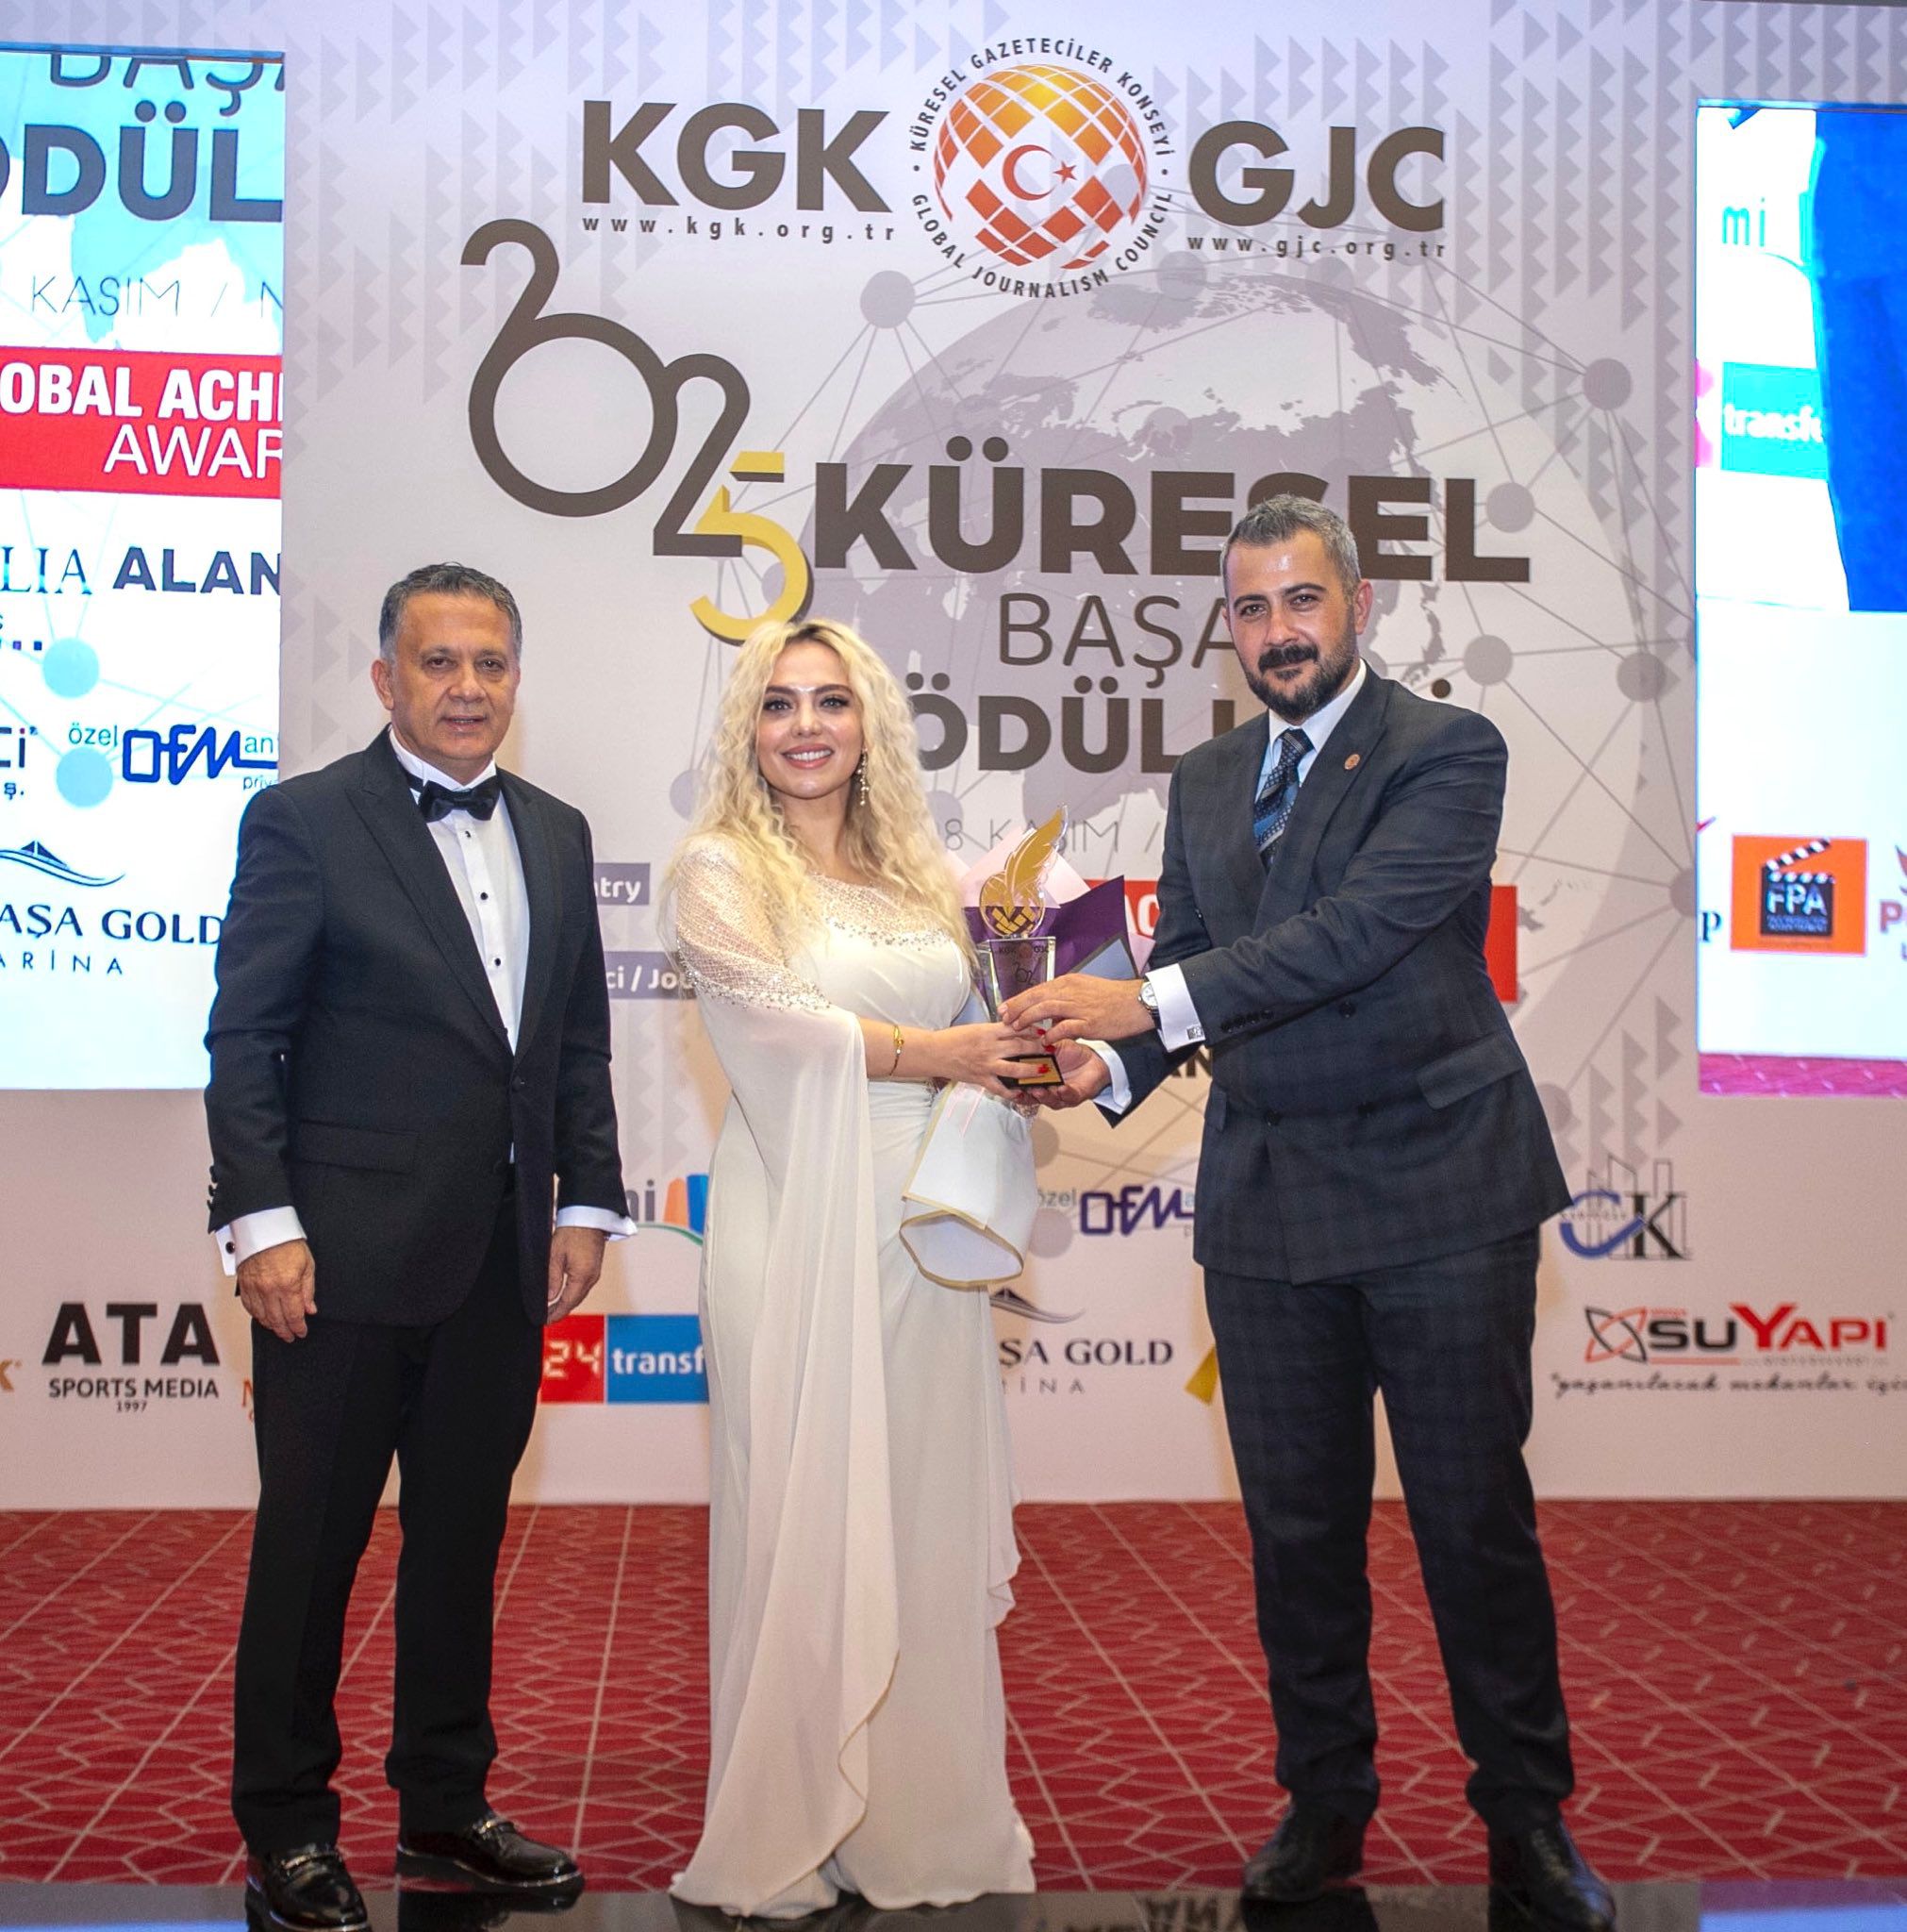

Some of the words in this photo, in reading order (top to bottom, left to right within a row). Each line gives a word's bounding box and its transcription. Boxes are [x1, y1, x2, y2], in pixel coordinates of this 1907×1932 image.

[909, 68, 967, 152] KÜRESEL
[970, 37, 1114, 74] GAZETECİLER
[1117, 71, 1176, 156] KONSEYİ
[0, 100, 282, 223] DÜL
[582, 99, 893, 213] KGK
[1188, 120, 1445, 233] GJC
[582, 216, 895, 244] www.kgk.org.tr
[911, 193, 967, 268] GLOBAL
[972, 266, 1109, 299] JOURNALISM
[1115, 192, 1172, 272] COUNCIL
[1187, 235, 1446, 261] www.gjc.org.tr
[31, 275, 180, 317] KASIM
[158, 368, 283, 422] ACH
[460, 218, 814, 647] 2025
[68, 721, 118, 747] özel
[594, 876, 641, 904] try
[1766, 882, 1829, 917] FPA
[41, 1302, 221, 1366] ATA
[1065, 1338, 1174, 1367] GOLD
[48, 1377, 138, 1399] SPORTS
[143, 1377, 220, 1399] MEDIA
[116, 1401, 148, 1413] 1997
